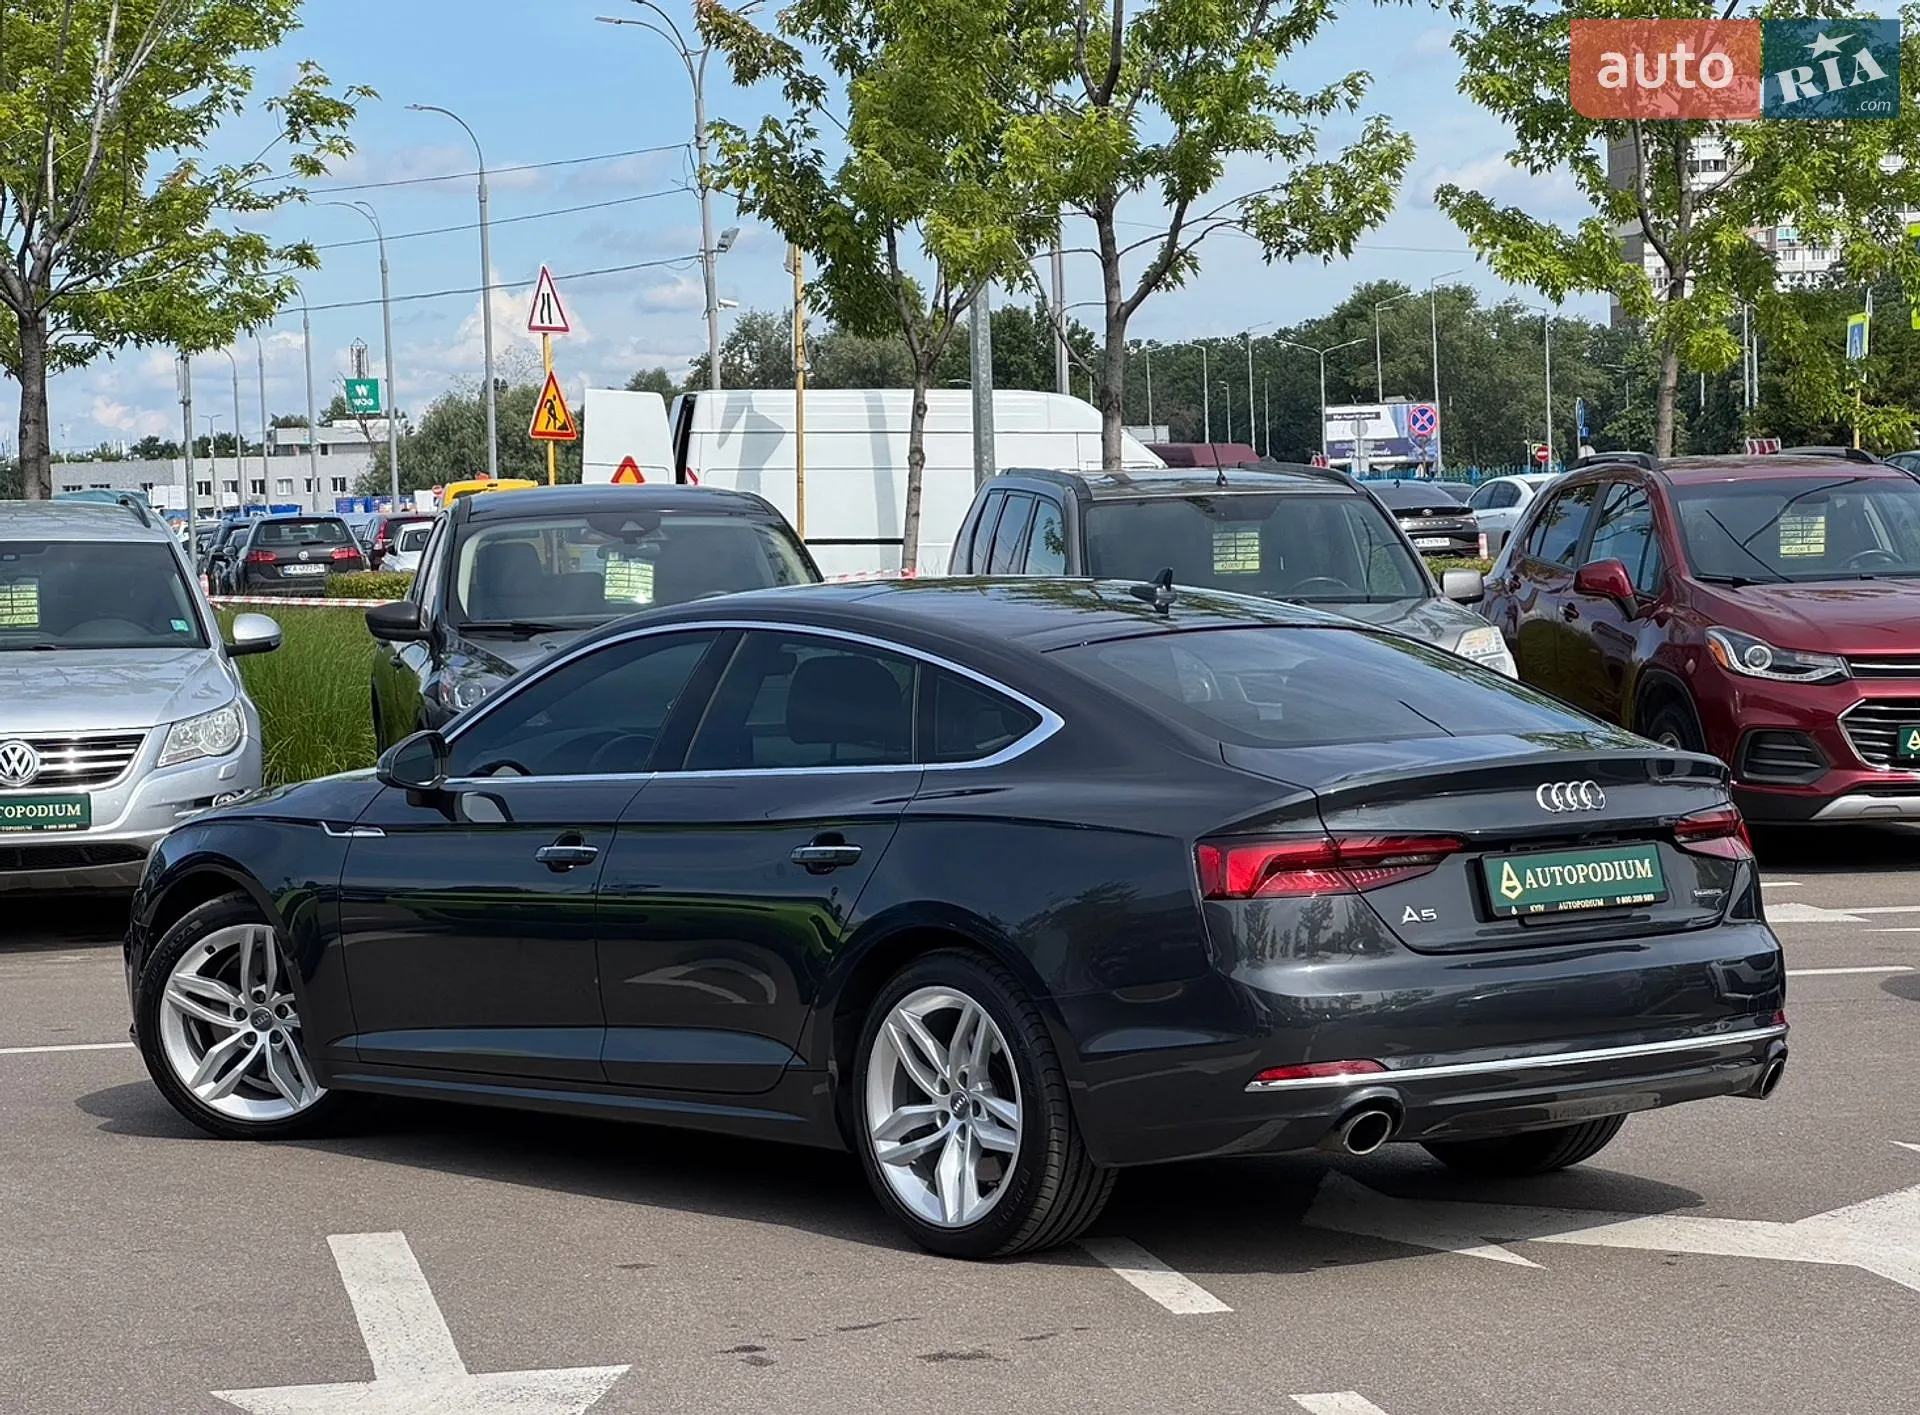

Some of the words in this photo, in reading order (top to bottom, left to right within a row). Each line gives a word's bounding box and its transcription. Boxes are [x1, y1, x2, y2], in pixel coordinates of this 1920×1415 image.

[1525, 859, 1653, 889] AUTOPODIUM
[1558, 898, 1604, 911] AUTOPODIUM
[1401, 905, 1438, 926] A5
